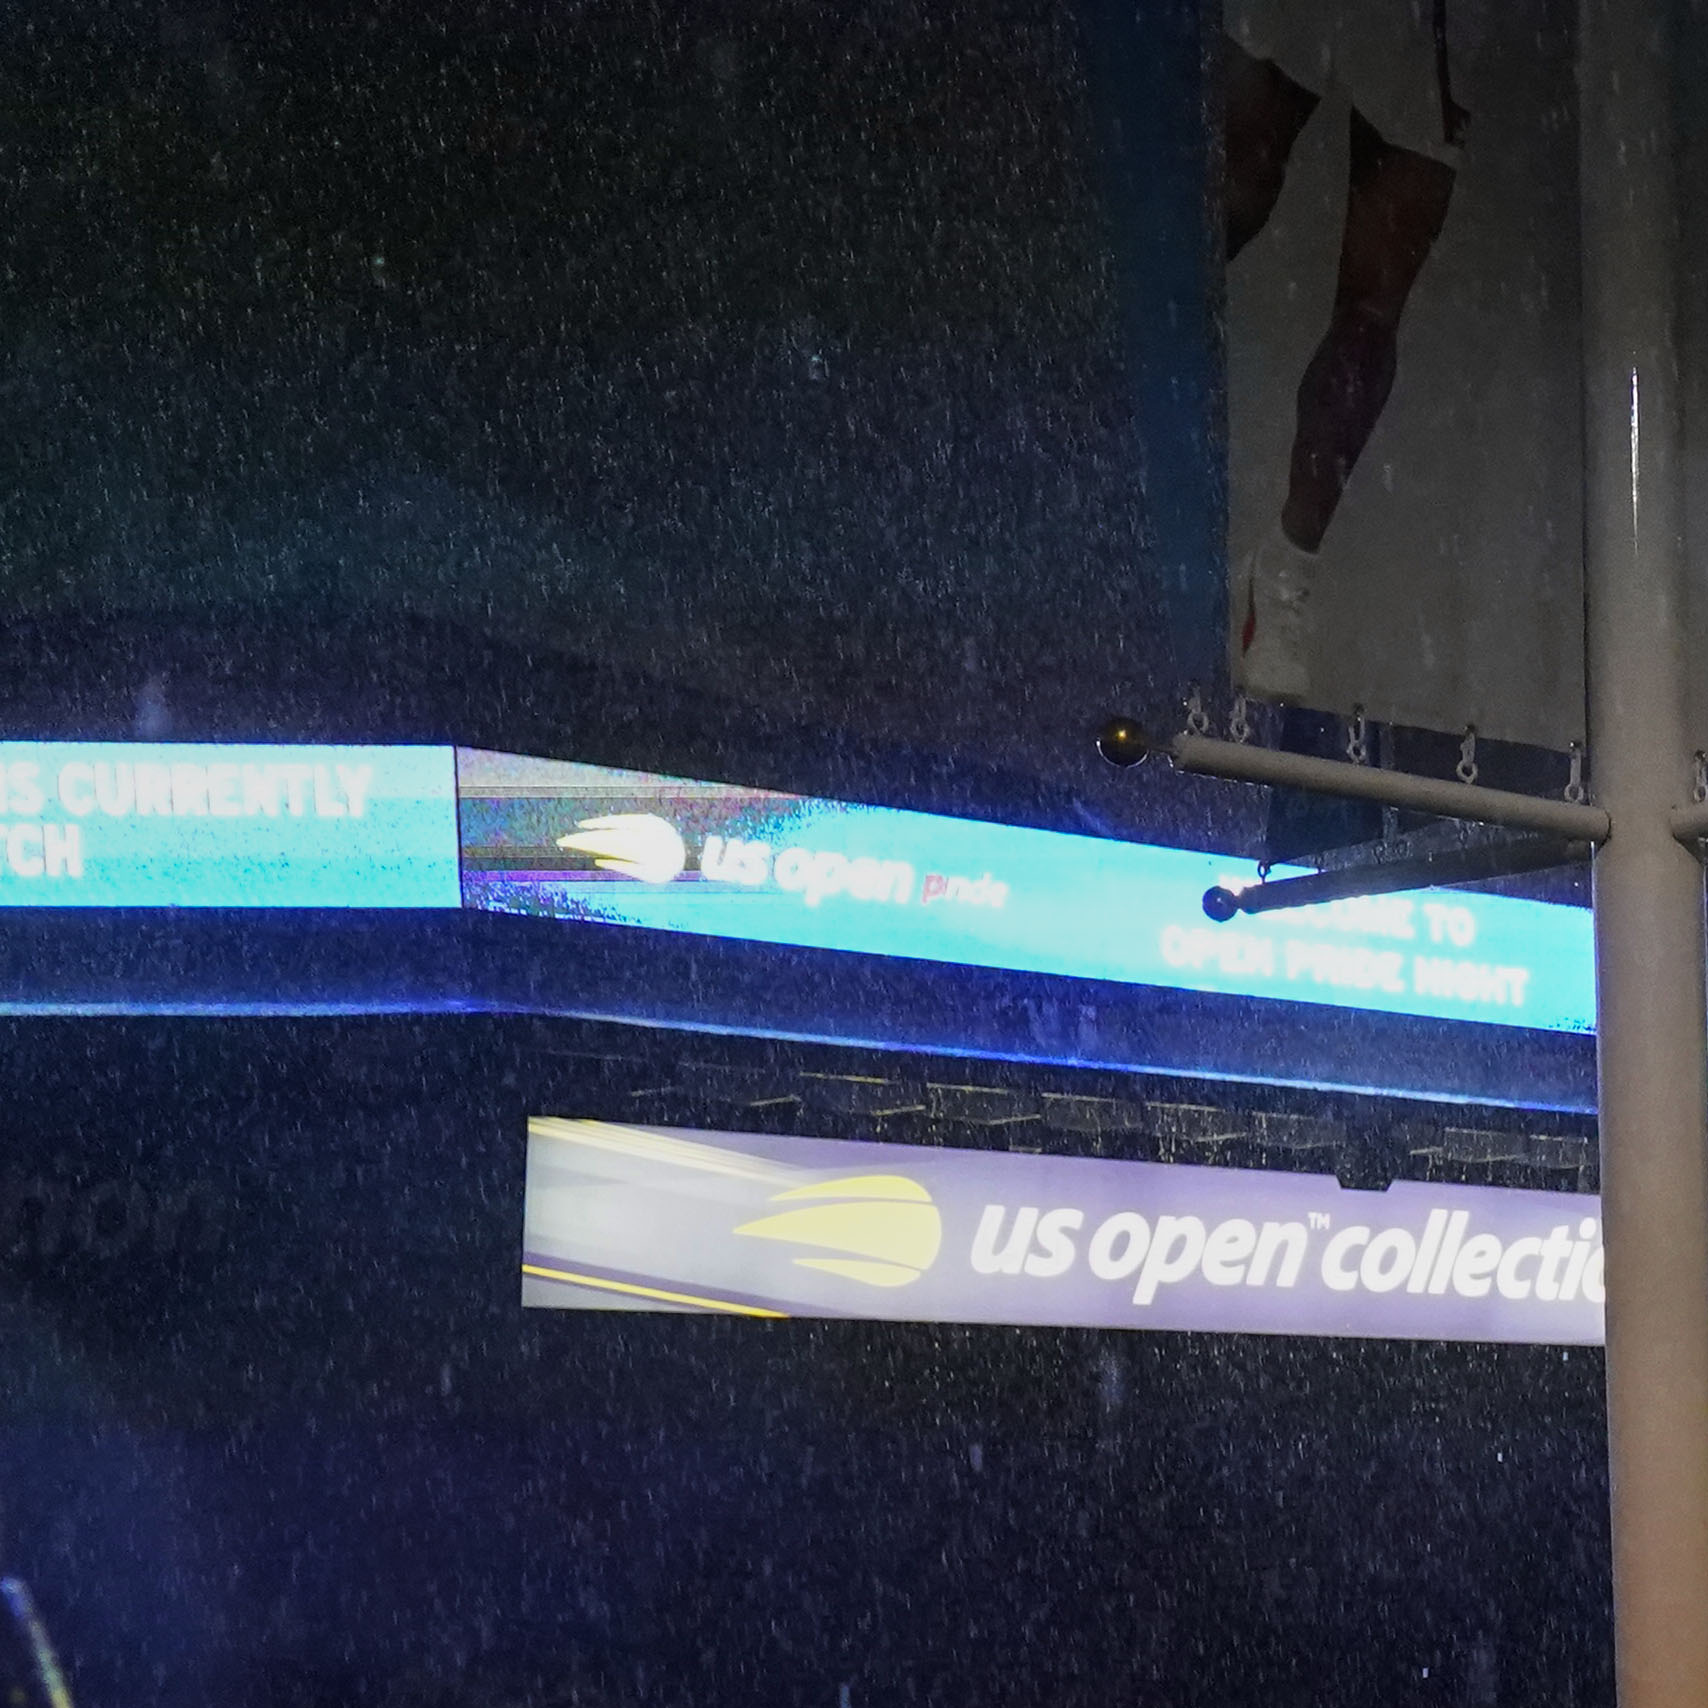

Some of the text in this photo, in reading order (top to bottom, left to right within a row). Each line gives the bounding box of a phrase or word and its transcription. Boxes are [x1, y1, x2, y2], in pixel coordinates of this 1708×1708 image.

[58, 761, 374, 817] CURRENTLY
[773, 846, 916, 907] open
[1424, 902, 1476, 948] TO
[970, 1203, 1084, 1276] us
